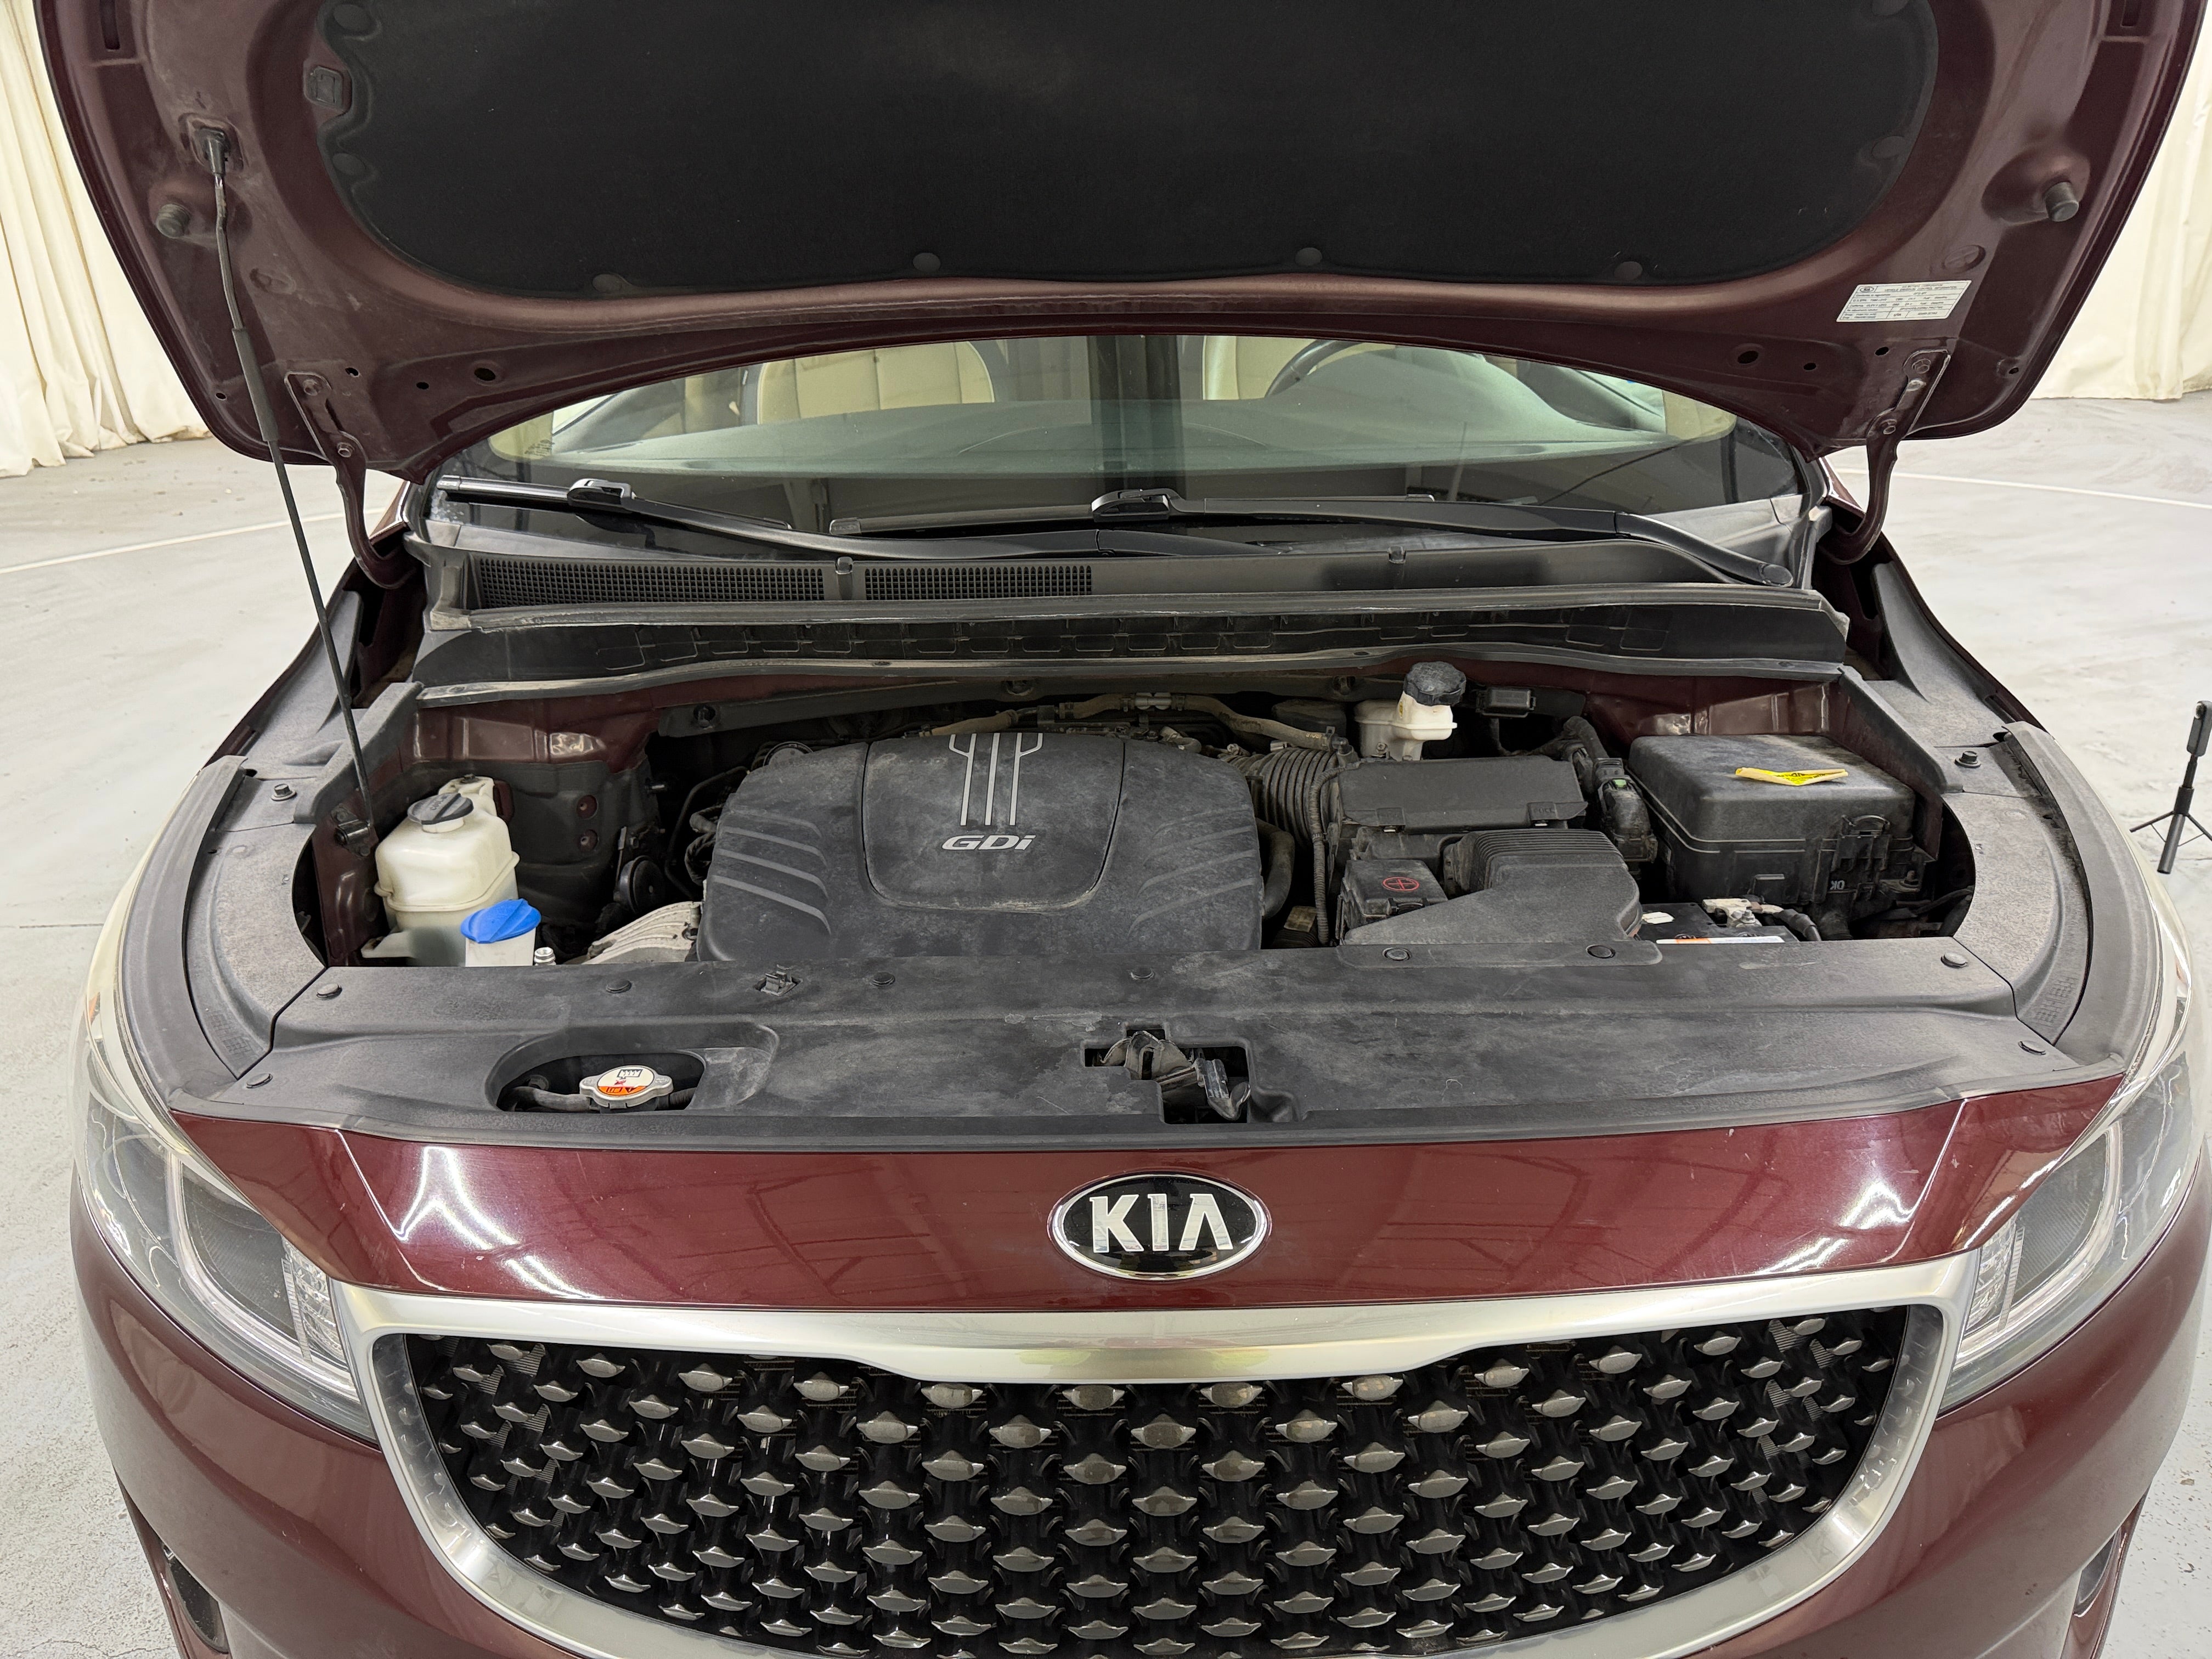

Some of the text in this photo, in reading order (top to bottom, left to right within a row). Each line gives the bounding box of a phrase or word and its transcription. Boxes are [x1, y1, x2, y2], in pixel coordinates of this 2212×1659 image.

[942, 835, 1036, 850] GDi
[1830, 880, 1845, 890] OK
[1090, 1193, 1233, 1253] KIA
